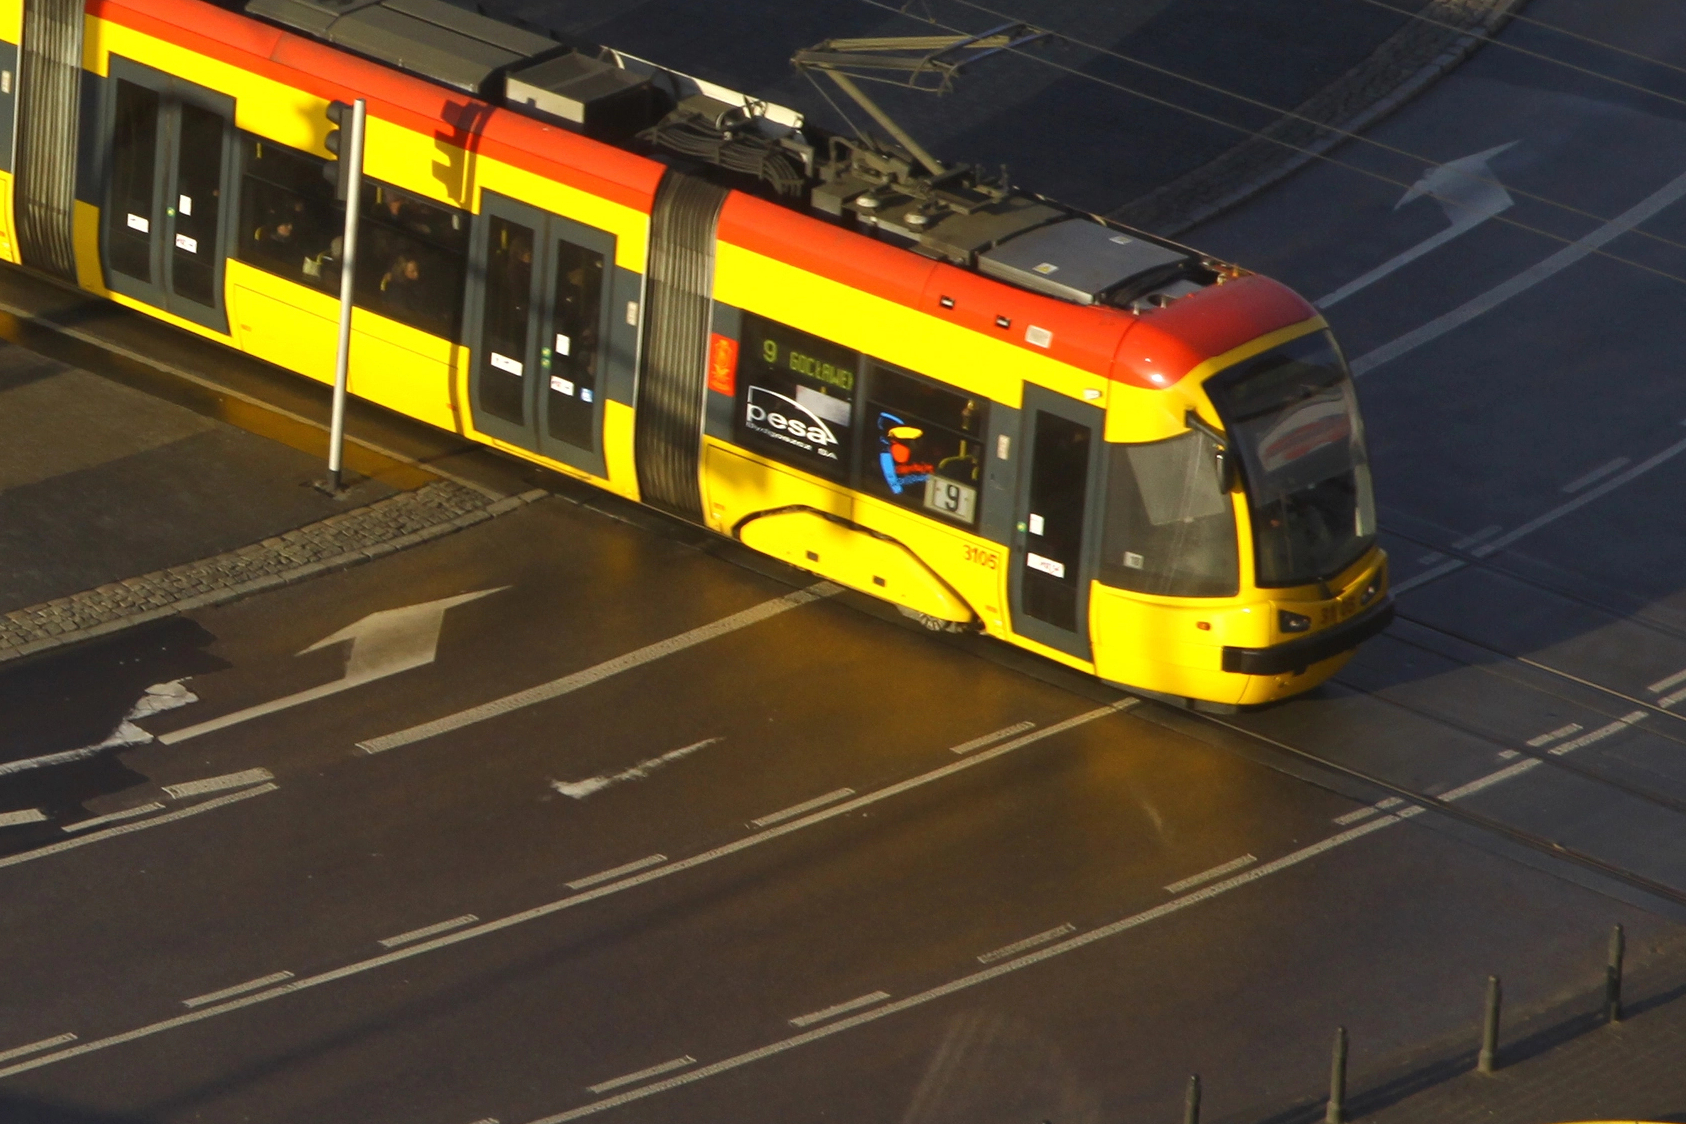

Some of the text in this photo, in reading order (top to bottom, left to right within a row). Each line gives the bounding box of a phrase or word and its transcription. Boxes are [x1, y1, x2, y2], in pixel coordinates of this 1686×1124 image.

[762, 339, 778, 363] 9
[745, 402, 829, 447] pesa
[945, 483, 961, 513] 9
[963, 544, 999, 570] 3105
